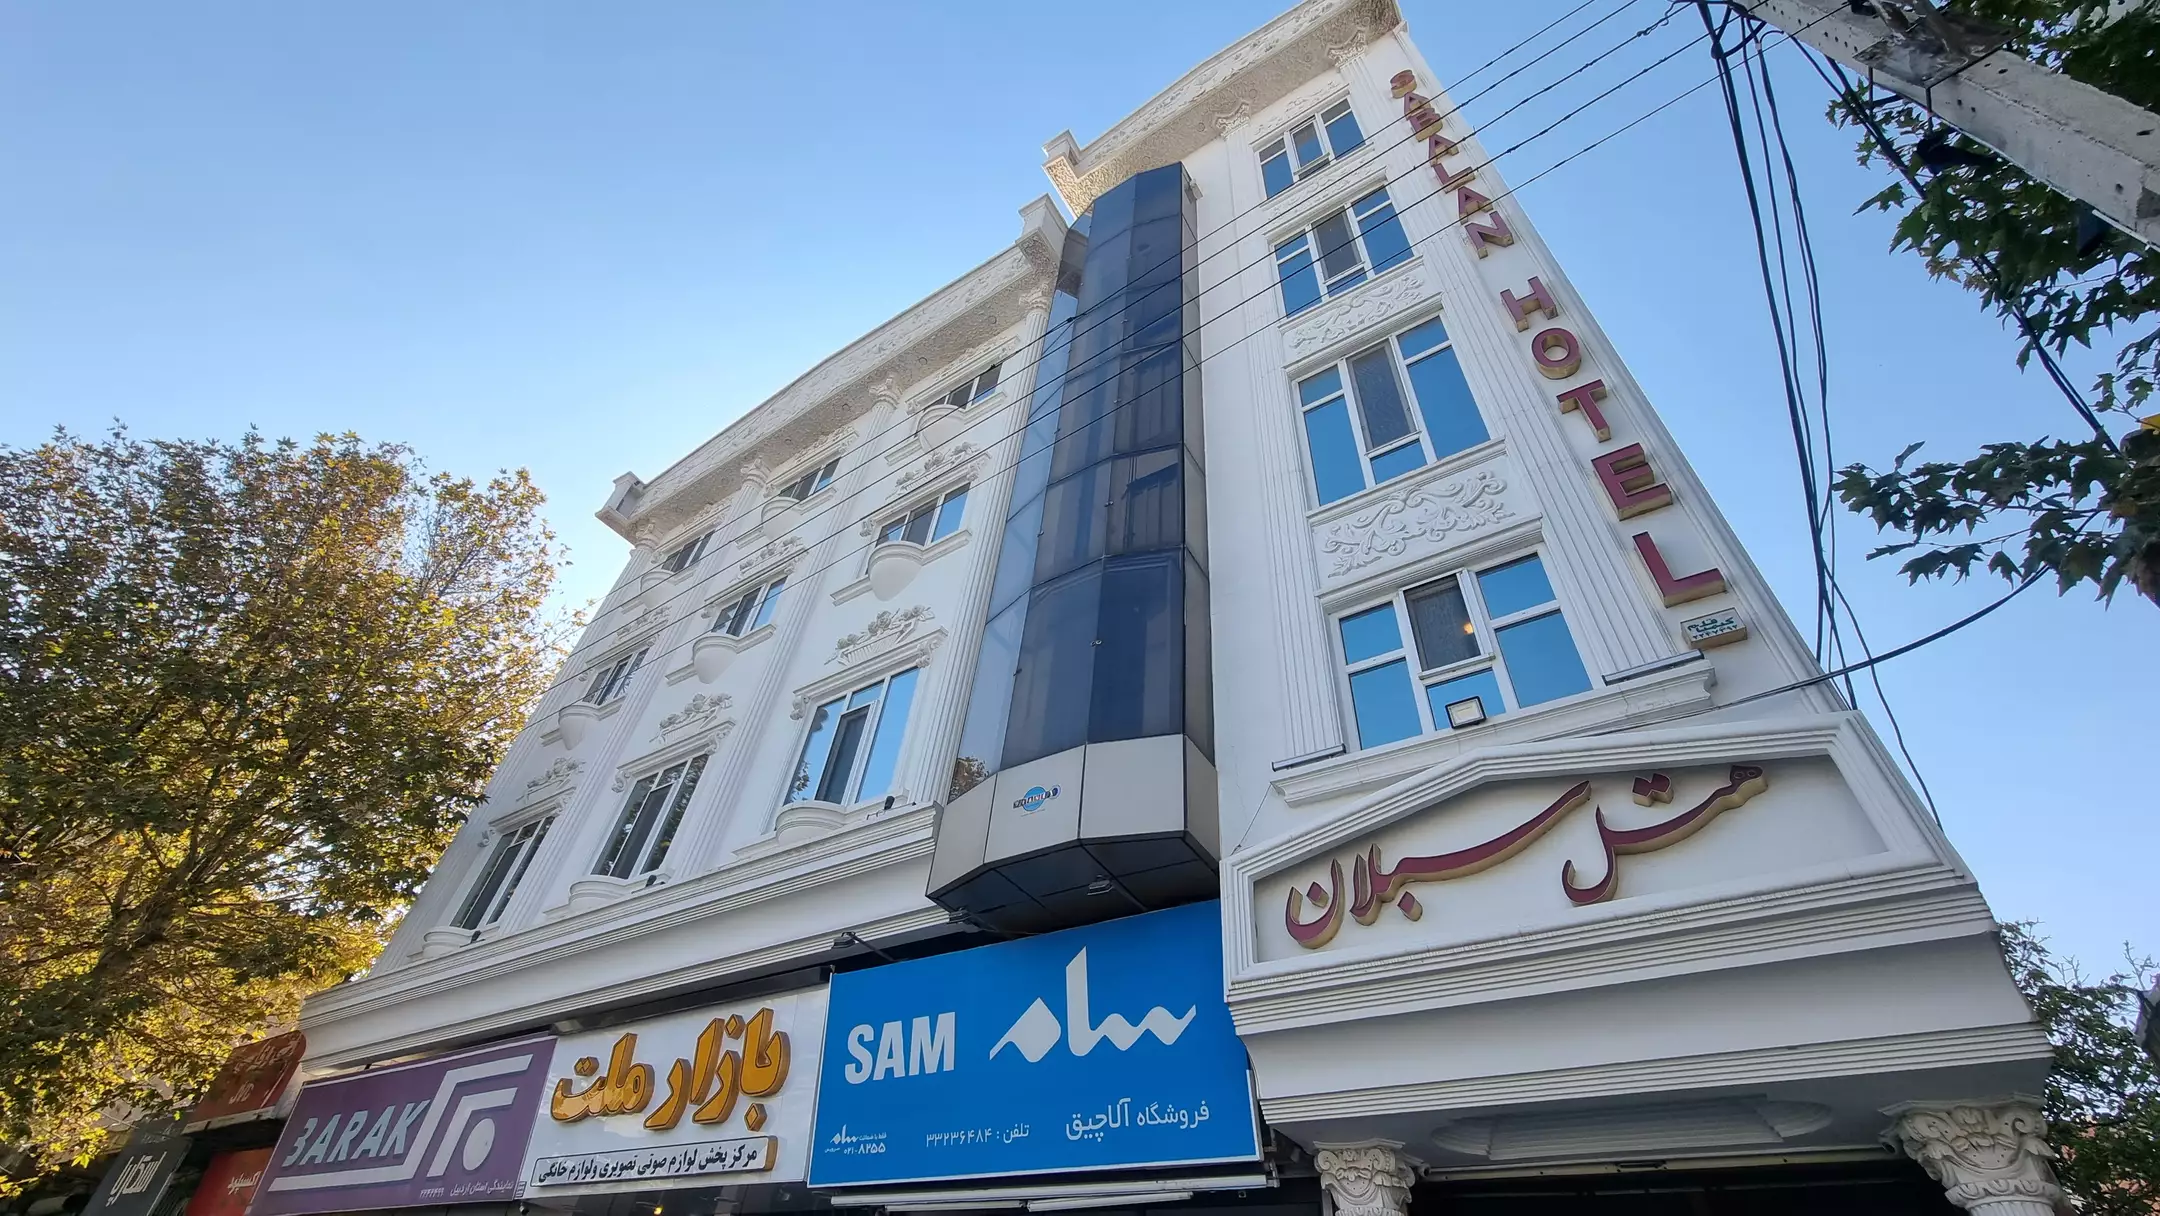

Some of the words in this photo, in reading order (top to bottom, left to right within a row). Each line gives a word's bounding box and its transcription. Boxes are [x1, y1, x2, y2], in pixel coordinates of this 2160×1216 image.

[1389, 69, 1514, 260] SABALAN
[1500, 275, 1727, 608] HOTEL
[1285, 780, 1593, 950] سبلان
[1561, 764, 1769, 908] هتل
[989, 946, 1197, 1063] سام
[549, 1032, 656, 1126] ملت
[643, 1007, 792, 1133] بازار
[844, 1012, 956, 1084] SAM
[282, 1099, 431, 1168] BARAK
[1065, 1097, 1132, 1142] آلاچیق
[1137, 1099, 1210, 1130] فروشگاه
[637, 1154, 667, 1176] صوتی
[667, 1149, 699, 1175] لوازم
[699, 1147, 729, 1171] پخش
[730, 1144, 758, 1170] مرکز
